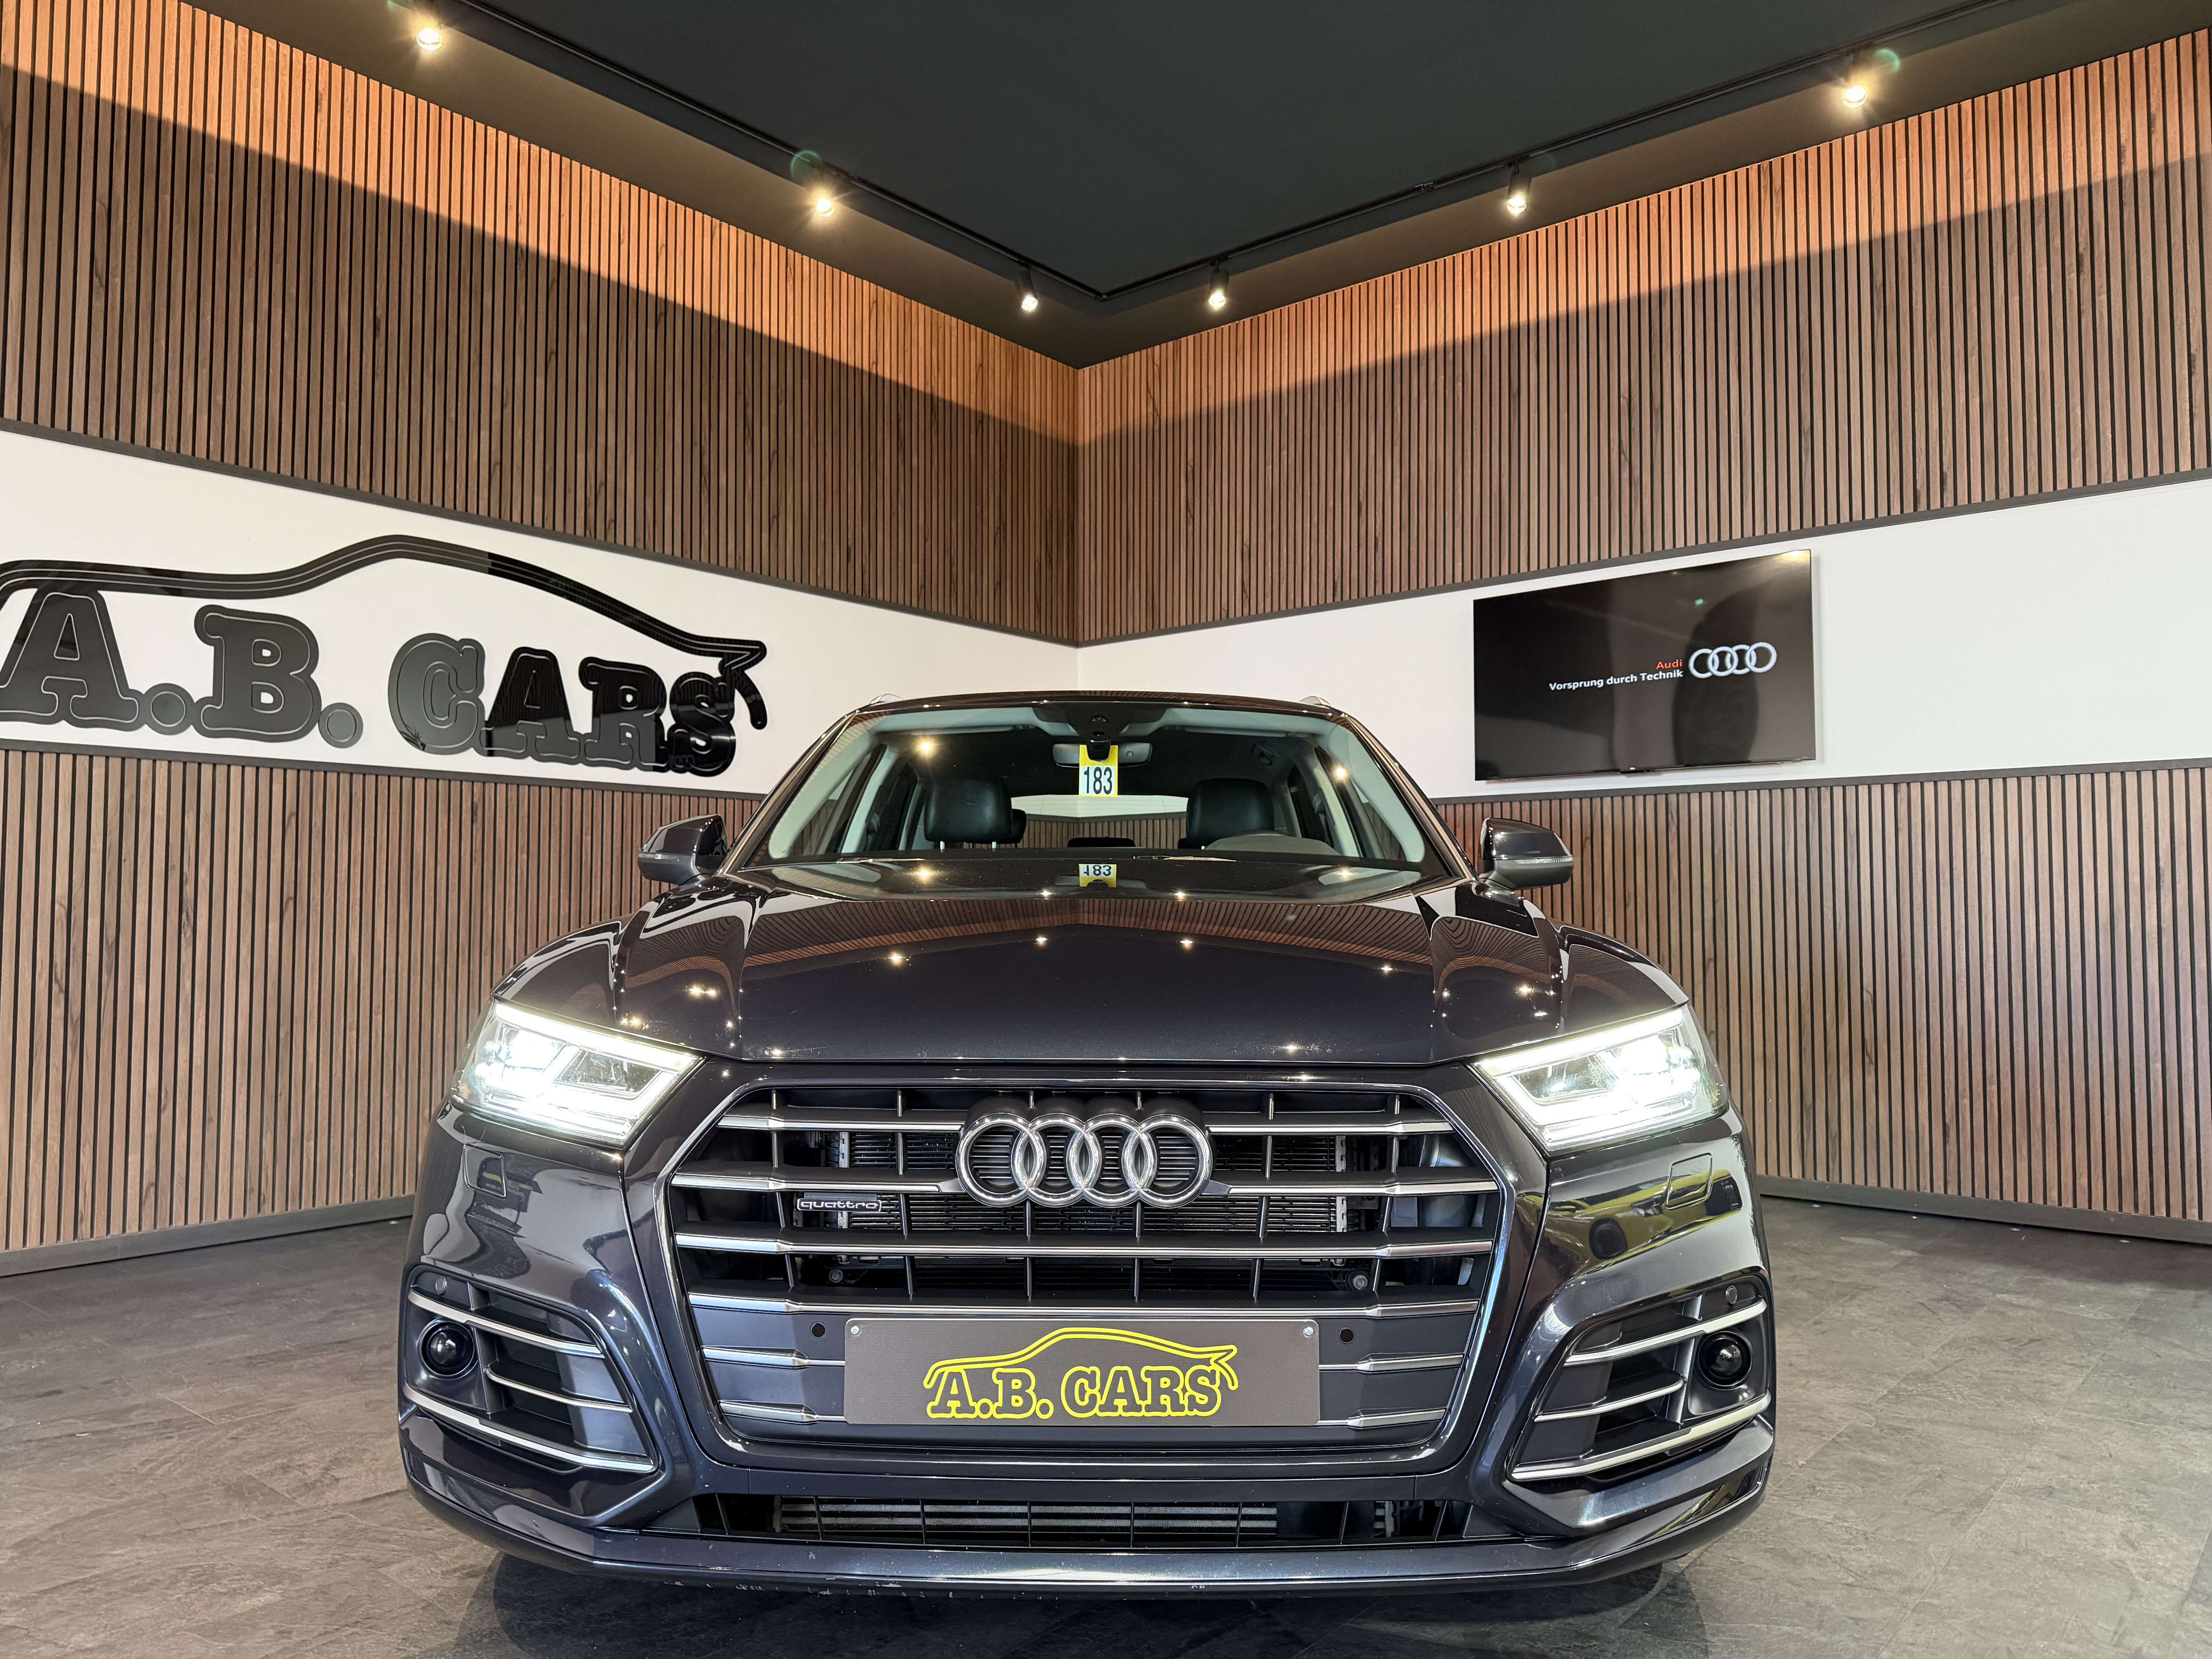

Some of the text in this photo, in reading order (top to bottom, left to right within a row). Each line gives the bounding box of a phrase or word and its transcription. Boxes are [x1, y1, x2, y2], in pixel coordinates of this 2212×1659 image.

[1656, 659, 1683, 670] Audi
[0, 591, 736, 777] A.B. CARS
[1549, 670, 1683, 690] Vorsprung durch Technik
[1084, 766, 1112, 794] 183
[801, 1200, 878, 1209] quattro
[927, 1365, 1221, 1419] A.B. CARS
